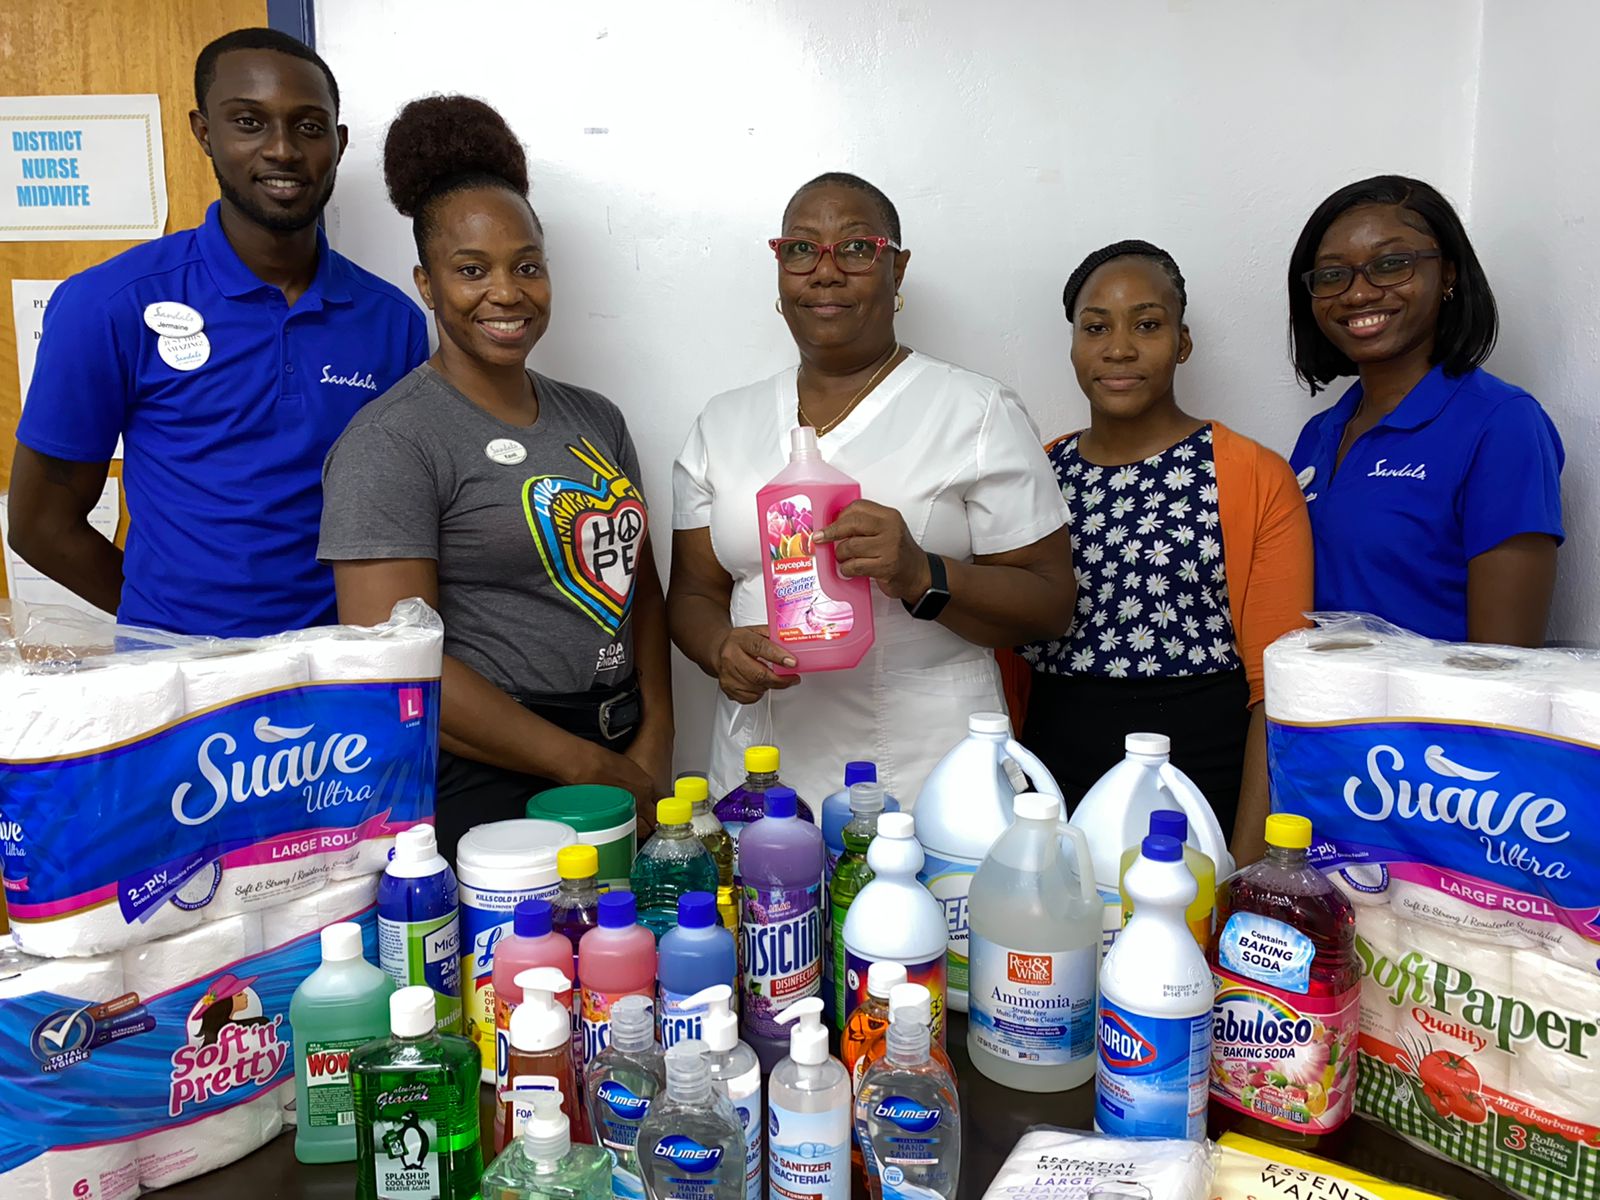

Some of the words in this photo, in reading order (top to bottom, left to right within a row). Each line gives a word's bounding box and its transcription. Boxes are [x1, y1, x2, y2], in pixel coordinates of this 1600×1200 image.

[12, 130, 82, 151] DISTRICT
[22, 158, 79, 179] NURSE
[16, 185, 90, 207] MIDWIFE
[154, 306, 194, 321] Sandals
[157, 322, 189, 331] Jermaine
[320, 365, 377, 391] Sandals
[1368, 459, 1427, 480] Sandals
[775, 561, 812, 571] Joyceplus
[777, 582, 814, 596] Cleaner
[408, 699, 419, 716] L
[172, 732, 371, 825] Suave
[303, 780, 374, 813] Ultra
[1344, 745, 1570, 843] Suave
[4, 841, 26, 856] Ultra
[272, 841, 317, 858] LARGE
[321, 832, 358, 848] ROLL
[1480, 836, 1571, 880] Ultra
[128, 870, 168, 901] 2-ply
[235, 884, 254, 896] Soft
[265, 878, 290, 890] Strong
[476, 893, 493, 902] KILLS
[494, 895, 512, 903] COLD
[533, 888, 560, 900] VIRUSES
[1441, 877, 1497, 906] LARGE
[1503, 896, 1554, 916] ROLL
[1403, 899, 1420, 910] Soft
[1432, 908, 1460, 923] Strong
[1470, 917, 1515, 929] Resistente
[1251, 930, 1288, 948] Contains
[1239, 936, 1293, 961] BAKING
[1242, 951, 1281, 972] SODA
[1016, 967, 1050, 980] White
[991, 986, 1070, 1010] Ammonia
[1018, 987, 1040, 997] Clear
[1012, 1007, 1047, 1016] Streak-Free
[1040, 1016, 1064, 1024] Cleaner
[1099, 1015, 1143, 1062] LOROX
[1412, 1007, 1487, 1052] Quality
[44, 1051, 89, 1071] HYGIENE
[50, 1049, 82, 1063] TOTAL
[173, 1026, 248, 1078] Soft
[1223, 1047, 1262, 1058] BAKING
[1264, 1048, 1296, 1059] SODA
[170, 1046, 286, 1115] pretty
[377, 1087, 428, 1110] Glacial
[597, 1086, 650, 1108] blumen
[875, 1104, 940, 1119] blumen
[1520, 1107, 1585, 1136] Absorbente
[1504, 1125, 1527, 1151] 3
[1531, 1132, 1565, 1151] Rollos
[654, 1143, 721, 1159] blumen
[890, 1151, 934, 1159] SANITIZER
[898, 1144, 925, 1152] HAND
[1530, 1142, 1568, 1162] Cocina
[780, 1158, 832, 1173] SANITIZER
[1036, 1164, 1135, 1176] WAITROSE
[1039, 1155, 1137, 1170] ESSENTIAL
[385, 1172, 416, 1181] SPLASH
[418, 1172, 430, 1180] UP
[406, 1179, 430, 1187] DOWN
[1035, 1177, 1094, 1186] LARGE
[73, 1179, 89, 1197] 6
[670, 1192, 714, 1200] SANITIZER
[678, 1184, 705, 1193] HAND
[1006, 1186, 1104, 1194] CLEANING
